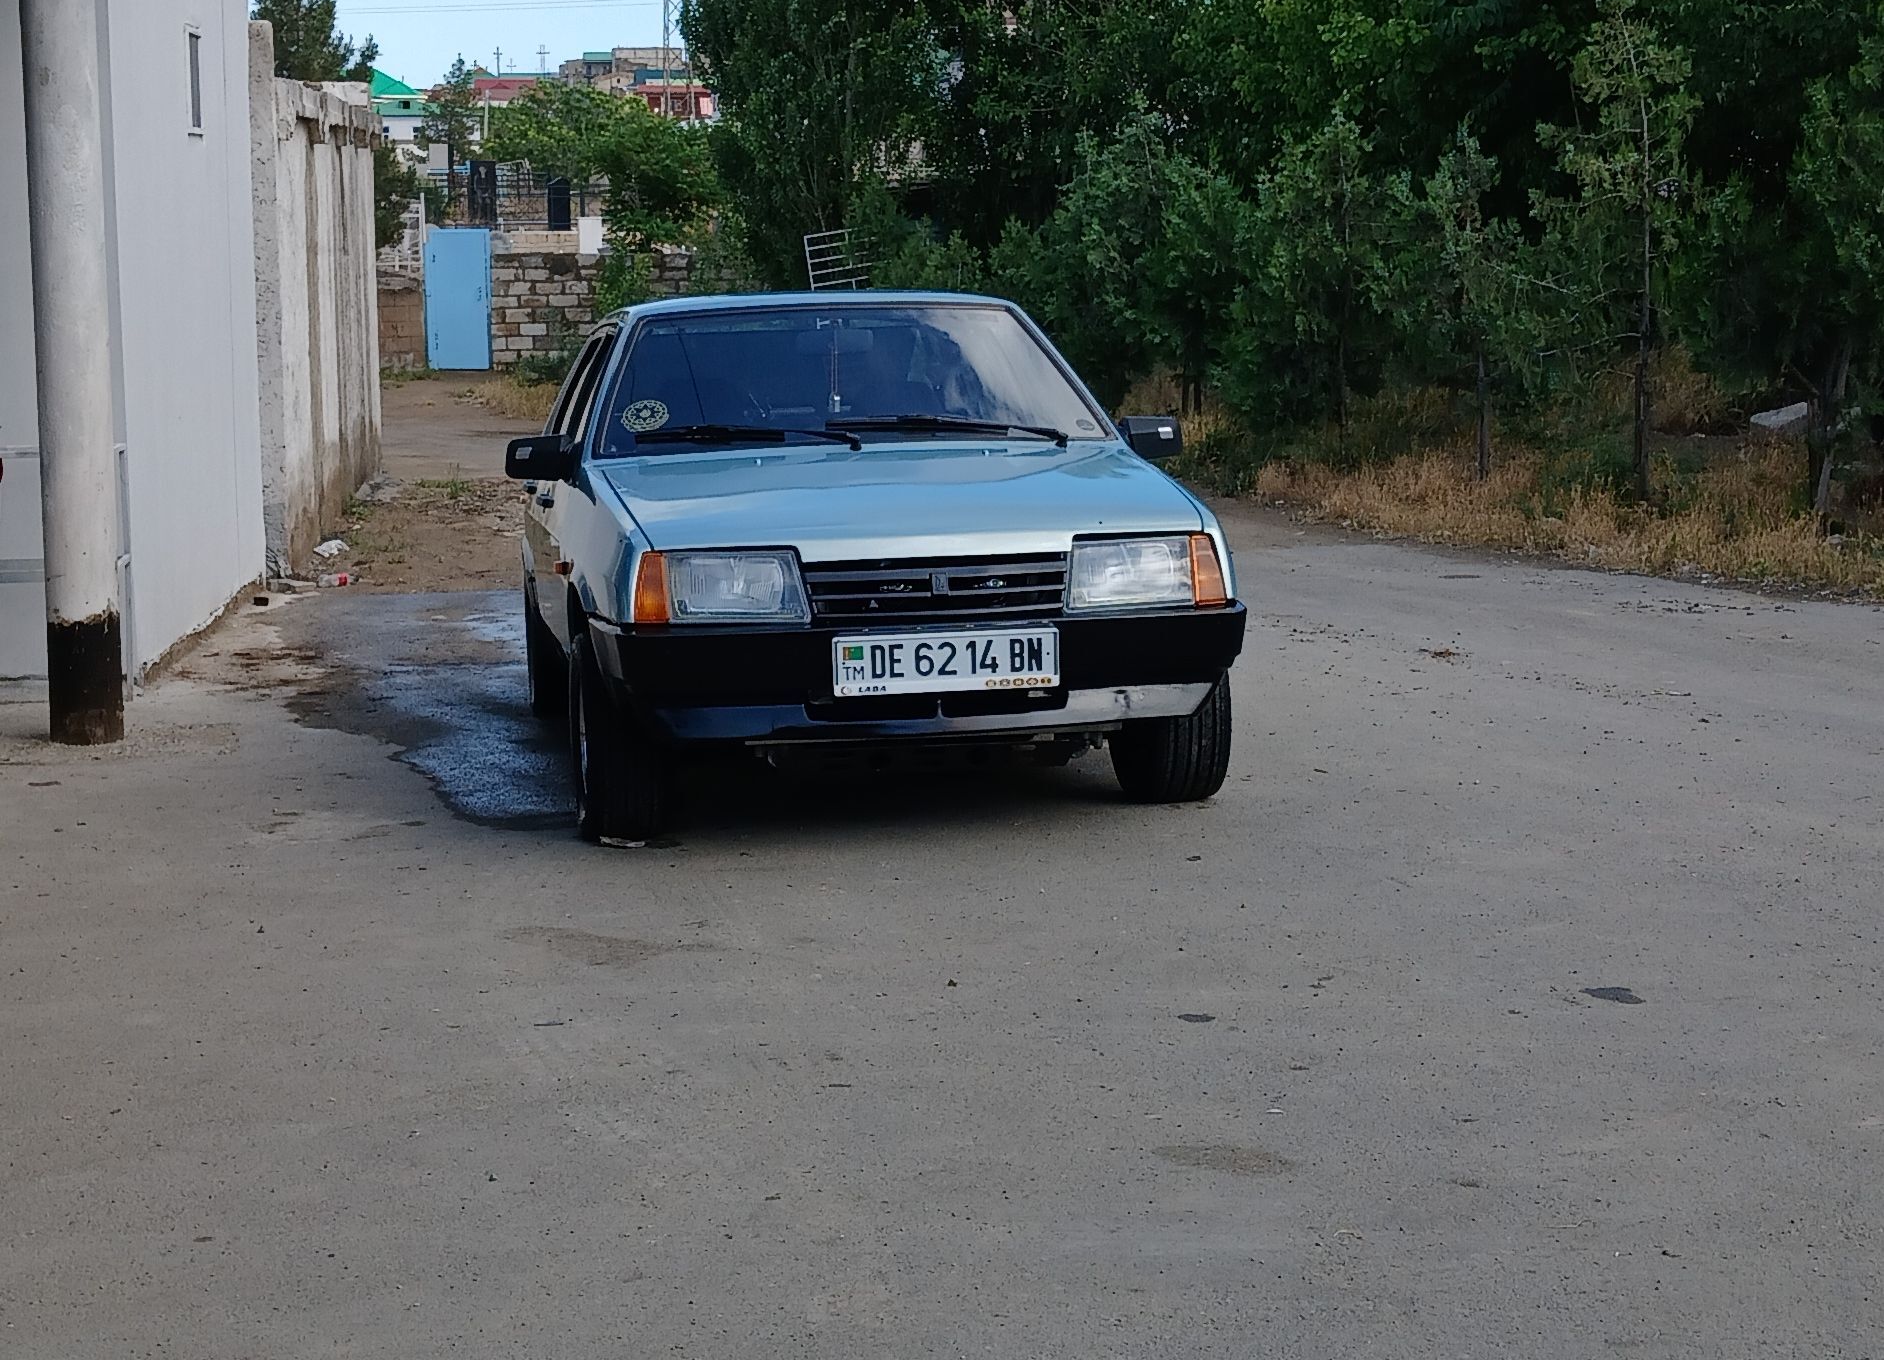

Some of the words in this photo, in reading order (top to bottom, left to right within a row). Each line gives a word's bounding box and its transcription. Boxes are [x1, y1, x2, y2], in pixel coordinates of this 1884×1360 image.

[870, 644, 905, 679] DE
[1009, 637, 1043, 673] BN
[842, 666, 865, 681] TM
[858, 685, 887, 693] LADA
